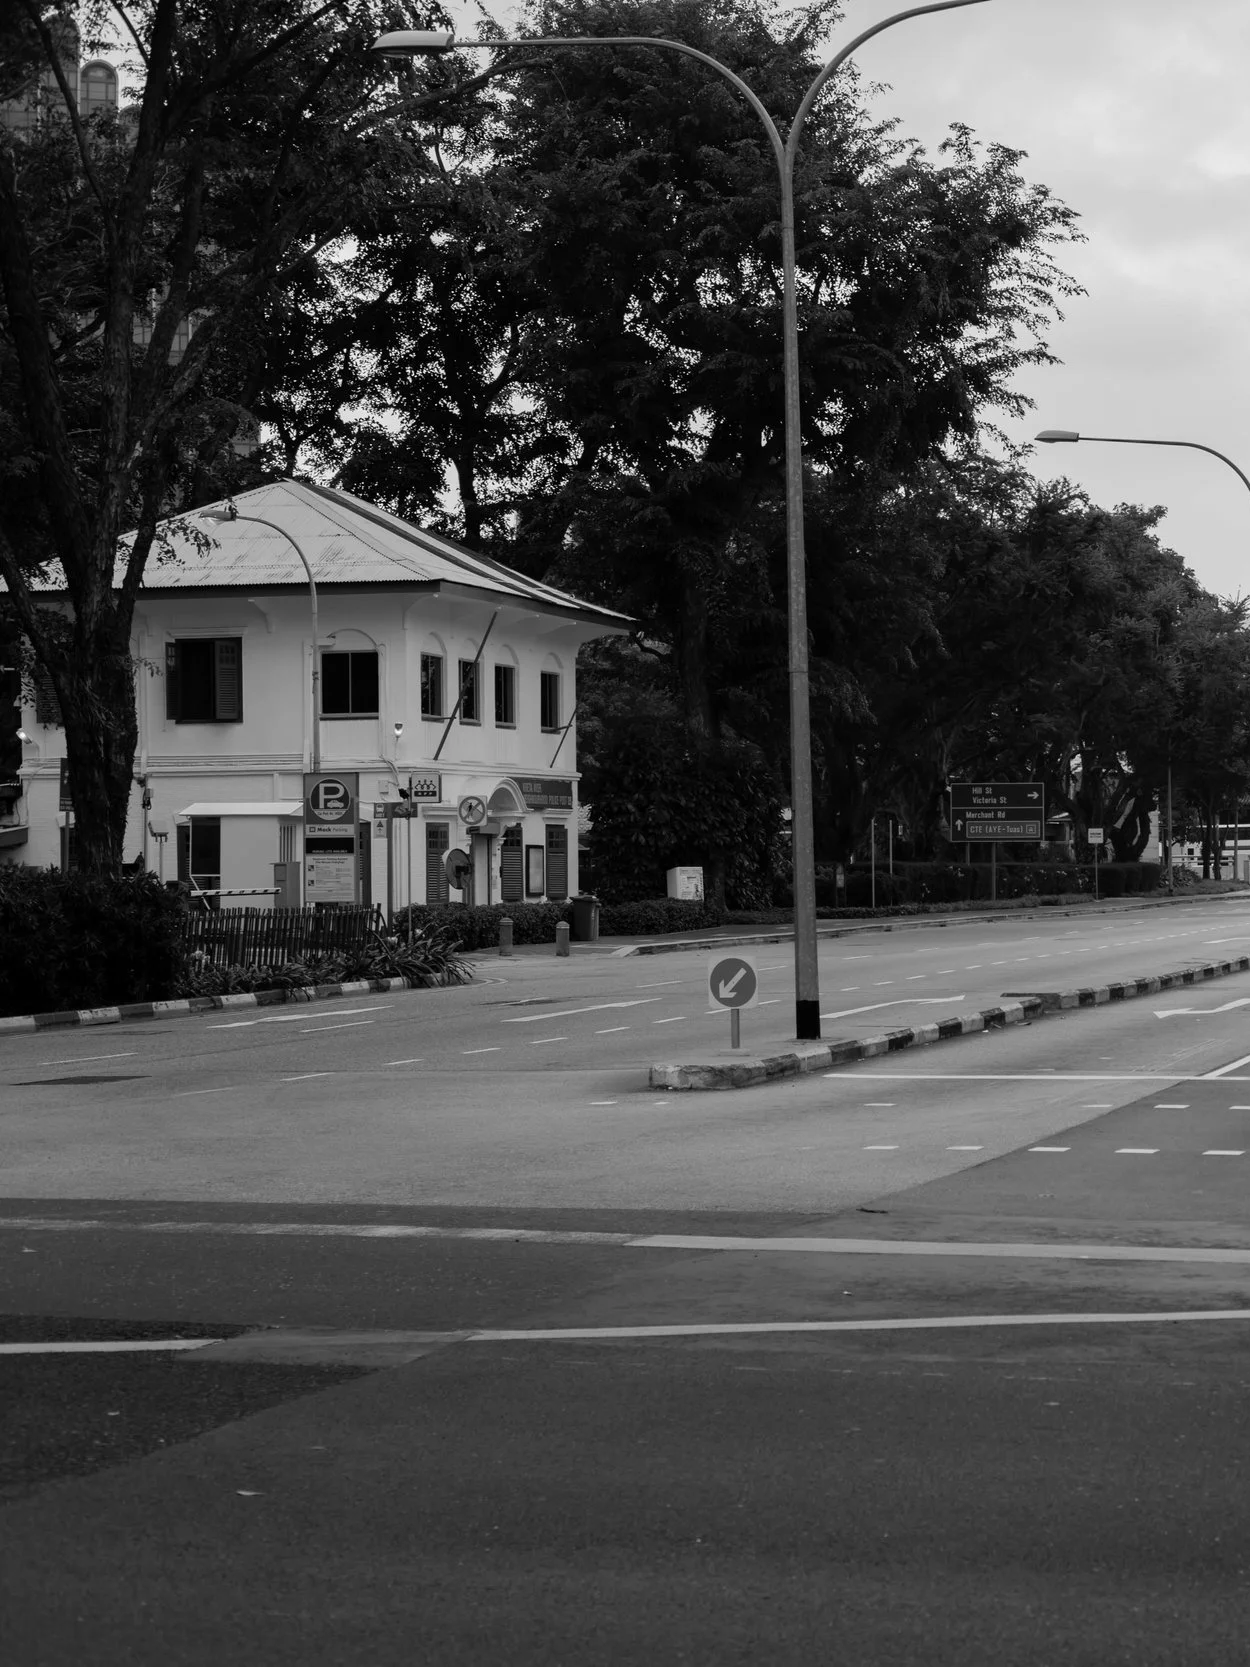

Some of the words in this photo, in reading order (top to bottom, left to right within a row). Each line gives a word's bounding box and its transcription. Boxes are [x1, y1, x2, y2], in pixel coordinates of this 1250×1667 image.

[972, 786, 983, 795] Hill
[985, 786, 993, 795] St
[319, 783, 345, 809] P
[972, 796, 997, 804] Victoria
[999, 796, 1007, 804] St
[965, 811, 995, 819] Merchant
[997, 811, 1006, 819] Rd
[970, 825, 983, 833] CTE
